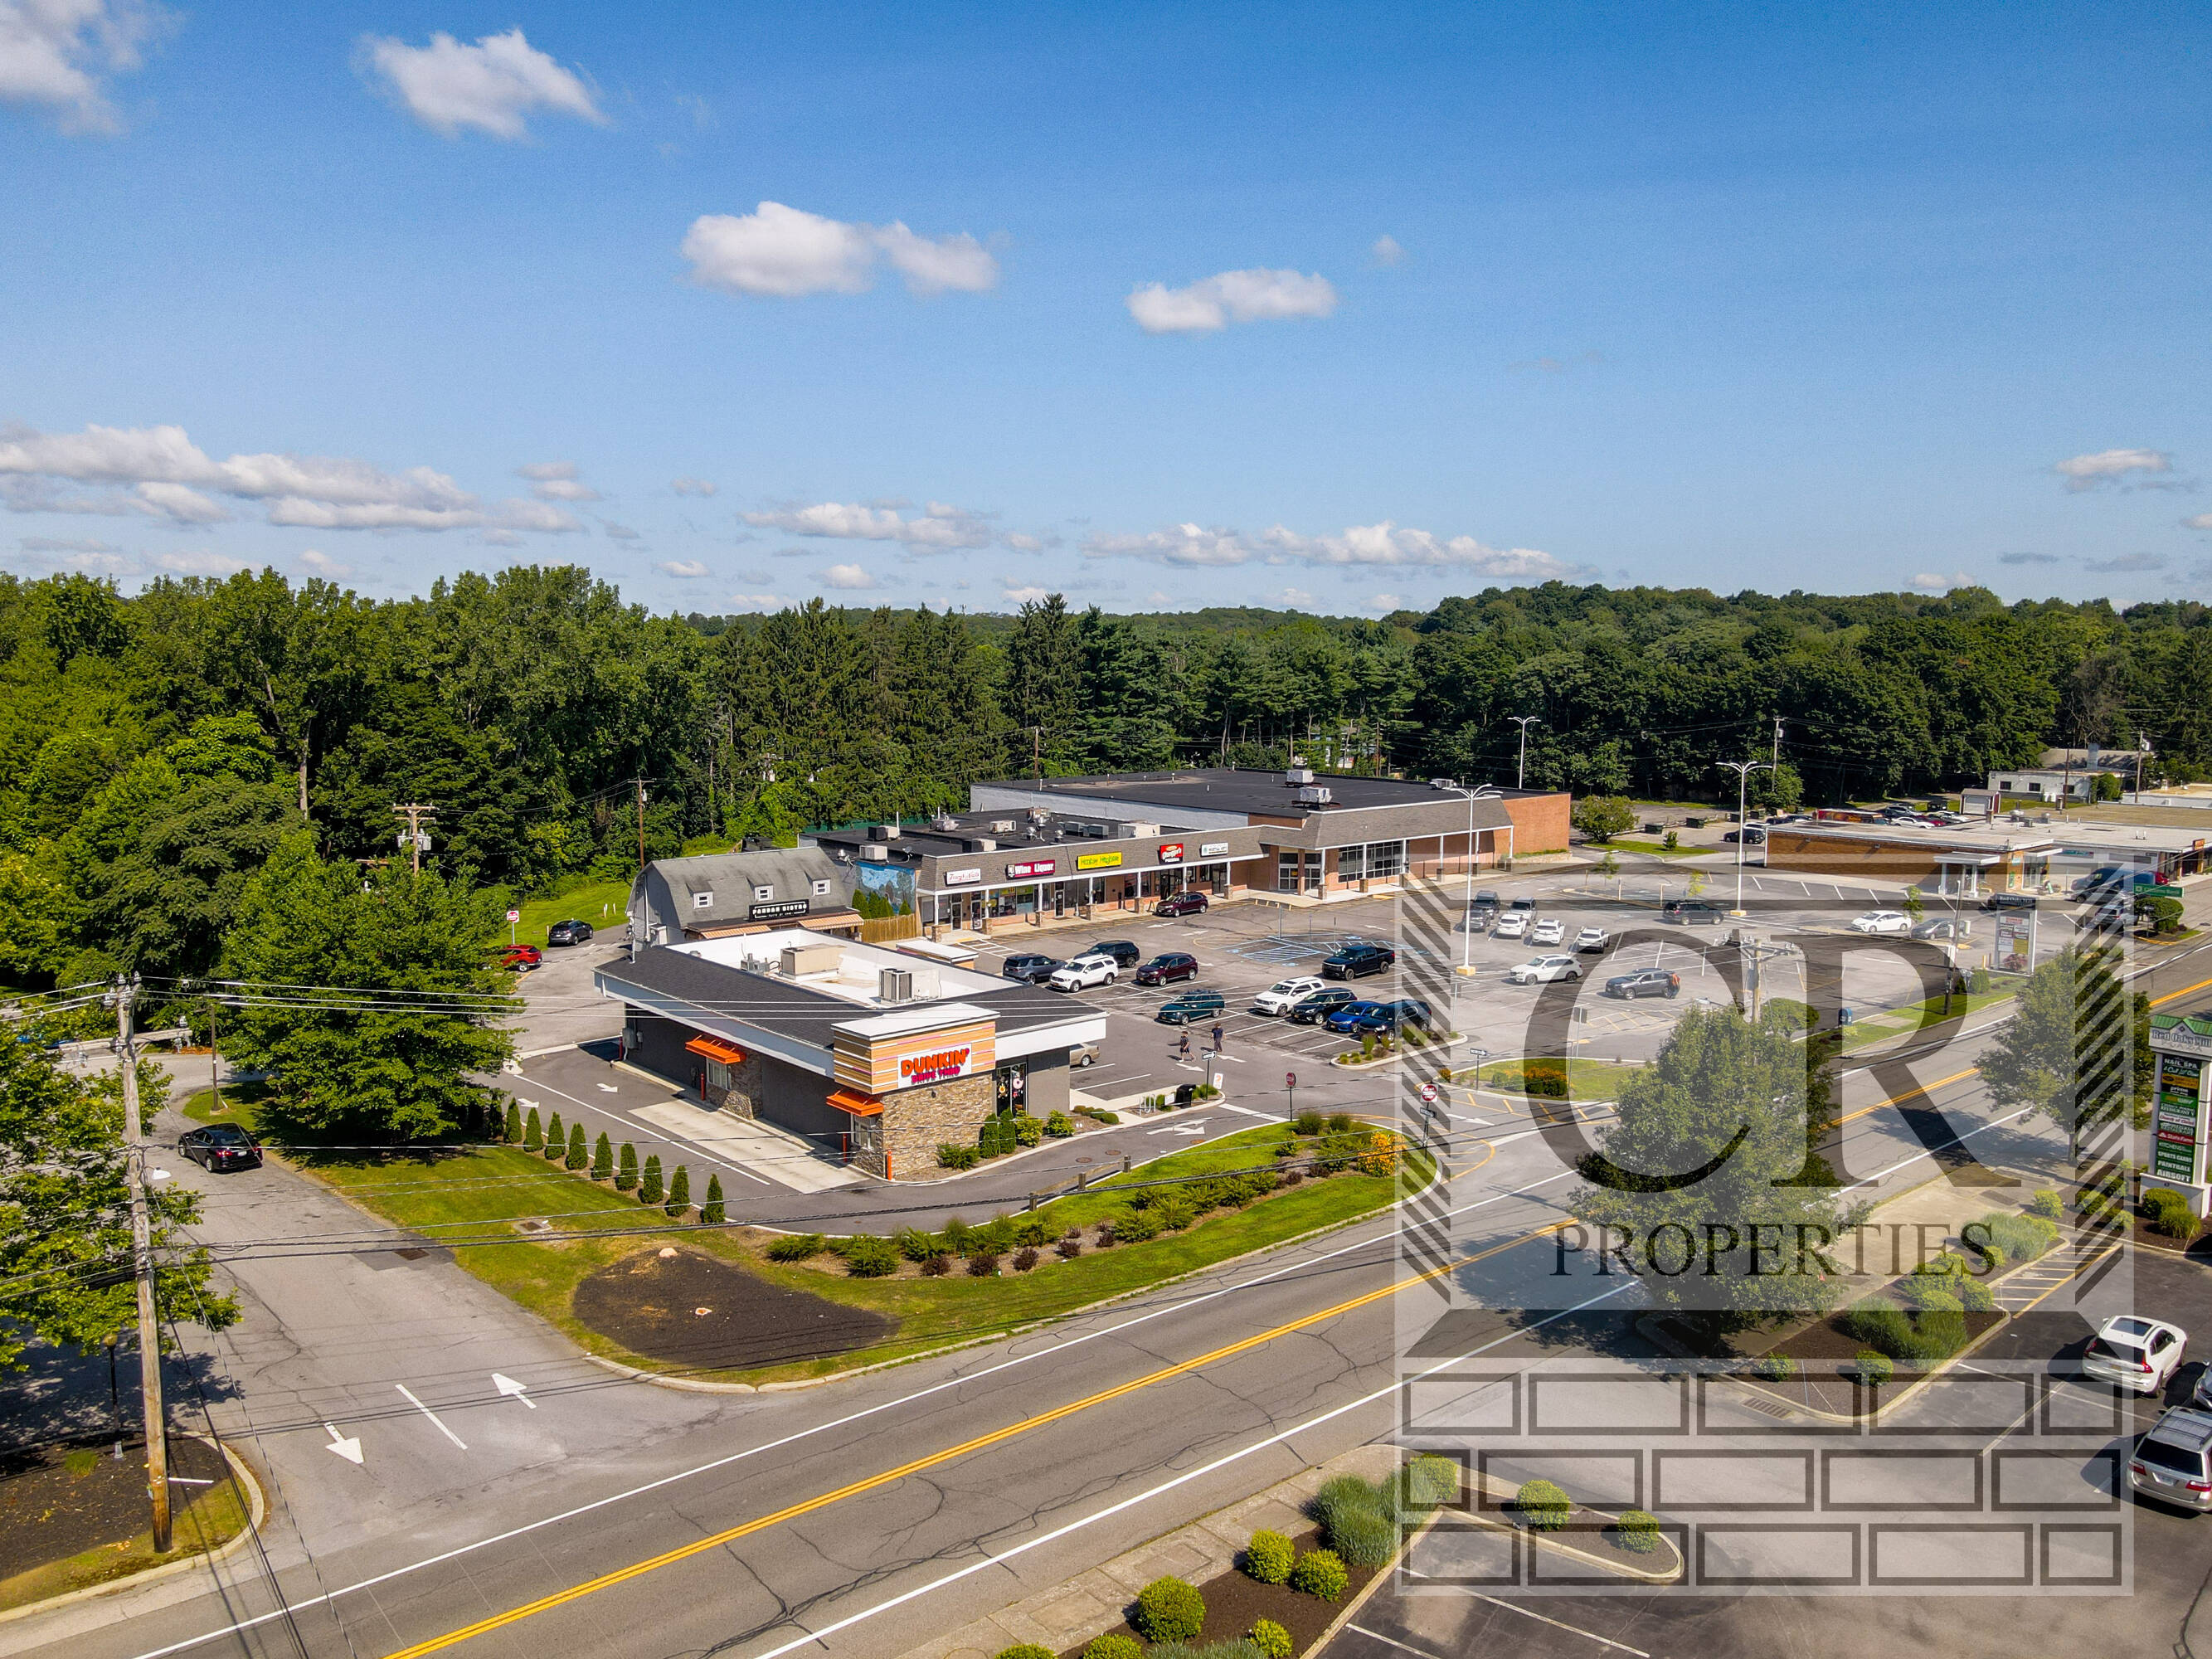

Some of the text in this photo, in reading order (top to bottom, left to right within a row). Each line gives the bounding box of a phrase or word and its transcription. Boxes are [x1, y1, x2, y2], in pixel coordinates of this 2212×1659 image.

[1014, 863, 1053, 874] Wine Liquor
[2152, 1029, 2212, 1048] Red Oaks Mill
[901, 1048, 970, 1077] DUNKIN'
[911, 1070, 936, 1084] DRIVE
[2157, 1160, 2190, 1172] PAINTBALL
[2156, 1169, 2191, 1182] AIRSOFT
